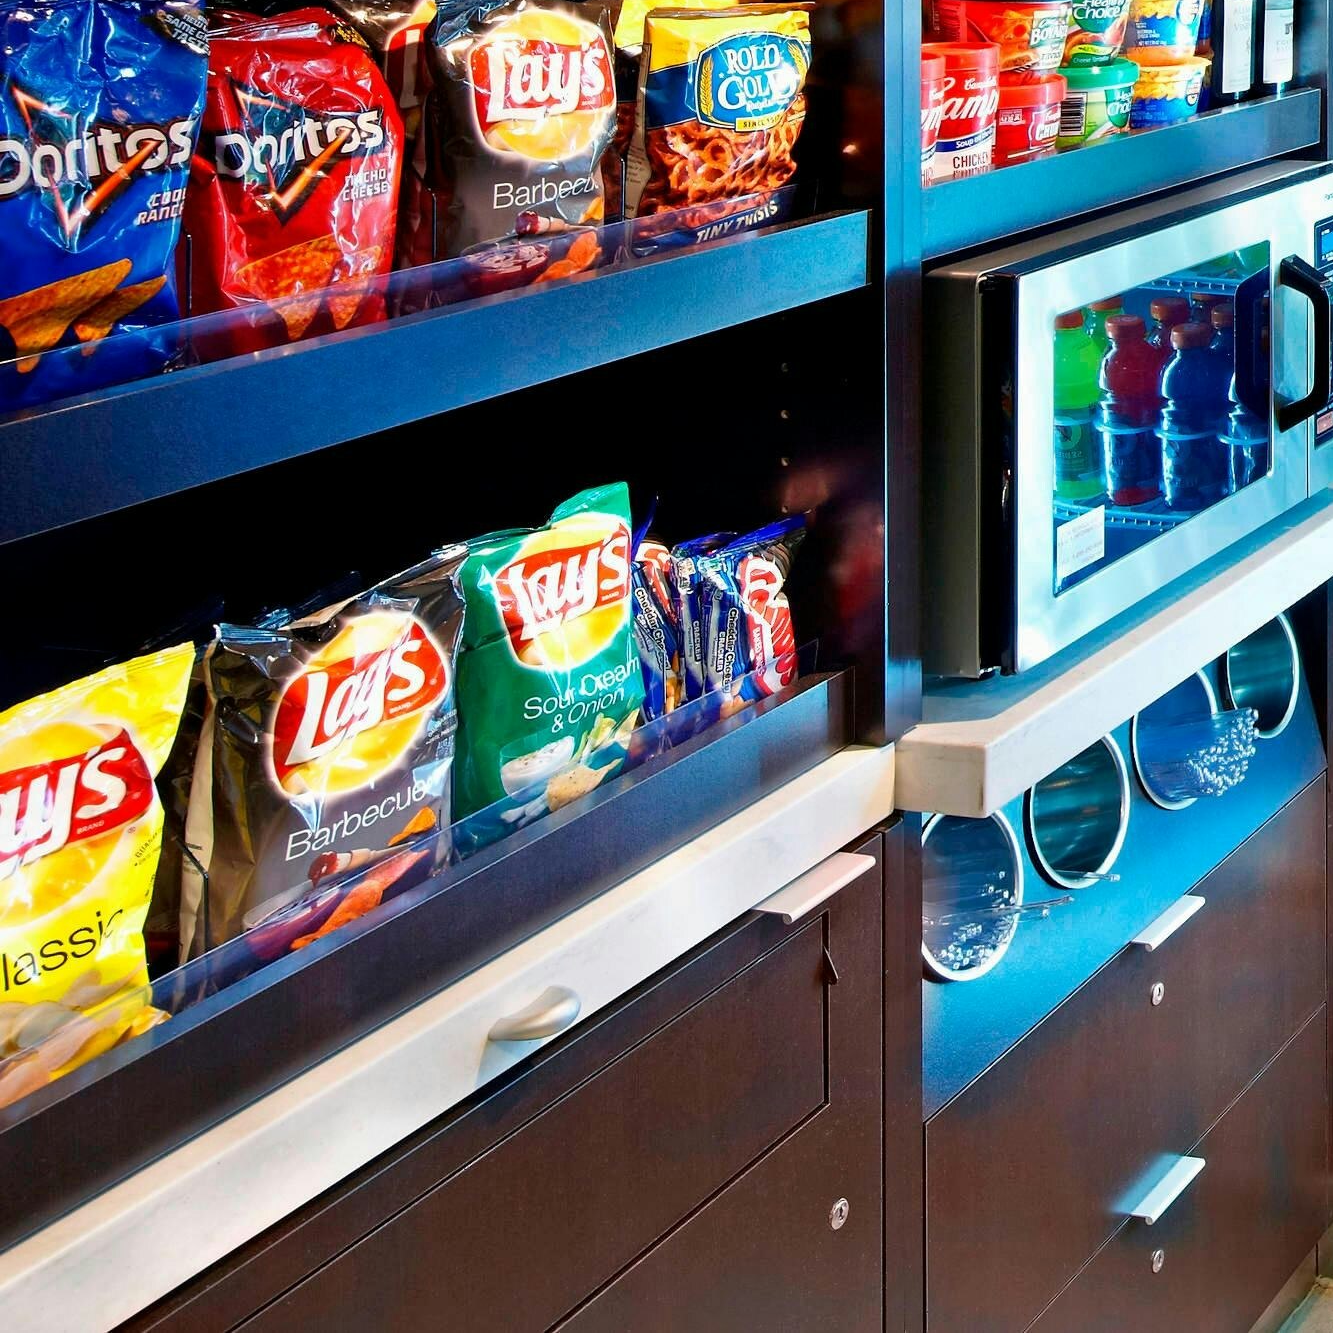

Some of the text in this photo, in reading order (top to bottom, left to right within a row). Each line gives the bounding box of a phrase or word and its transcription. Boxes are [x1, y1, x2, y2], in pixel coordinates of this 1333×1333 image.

[1073, 3, 1121, 20] Choice
[486, 42, 605, 122] Lay's
[724, 44, 781, 75] ROLD
[717, 70, 798, 110] GOLD
[0, 121, 195, 196] Doritos
[215, 111, 383, 178] Doritos
[955, 136, 974, 149] Soup
[343, 182, 388, 201] CHEESE
[345, 169, 387, 187] NACHO
[493, 174, 599, 210] Barbecu
[696, 200, 779, 244] TINY TWISTS
[508, 534, 629, 641] Lay's
[284, 636, 427, 766] Lay's
[523, 656, 641, 720] Sour Cream
[551, 687, 625, 733] & Onion
[76, 819, 105, 834] BRAND
[285, 782, 430, 862] Barbecue
[2, 908, 123, 992] lassic
